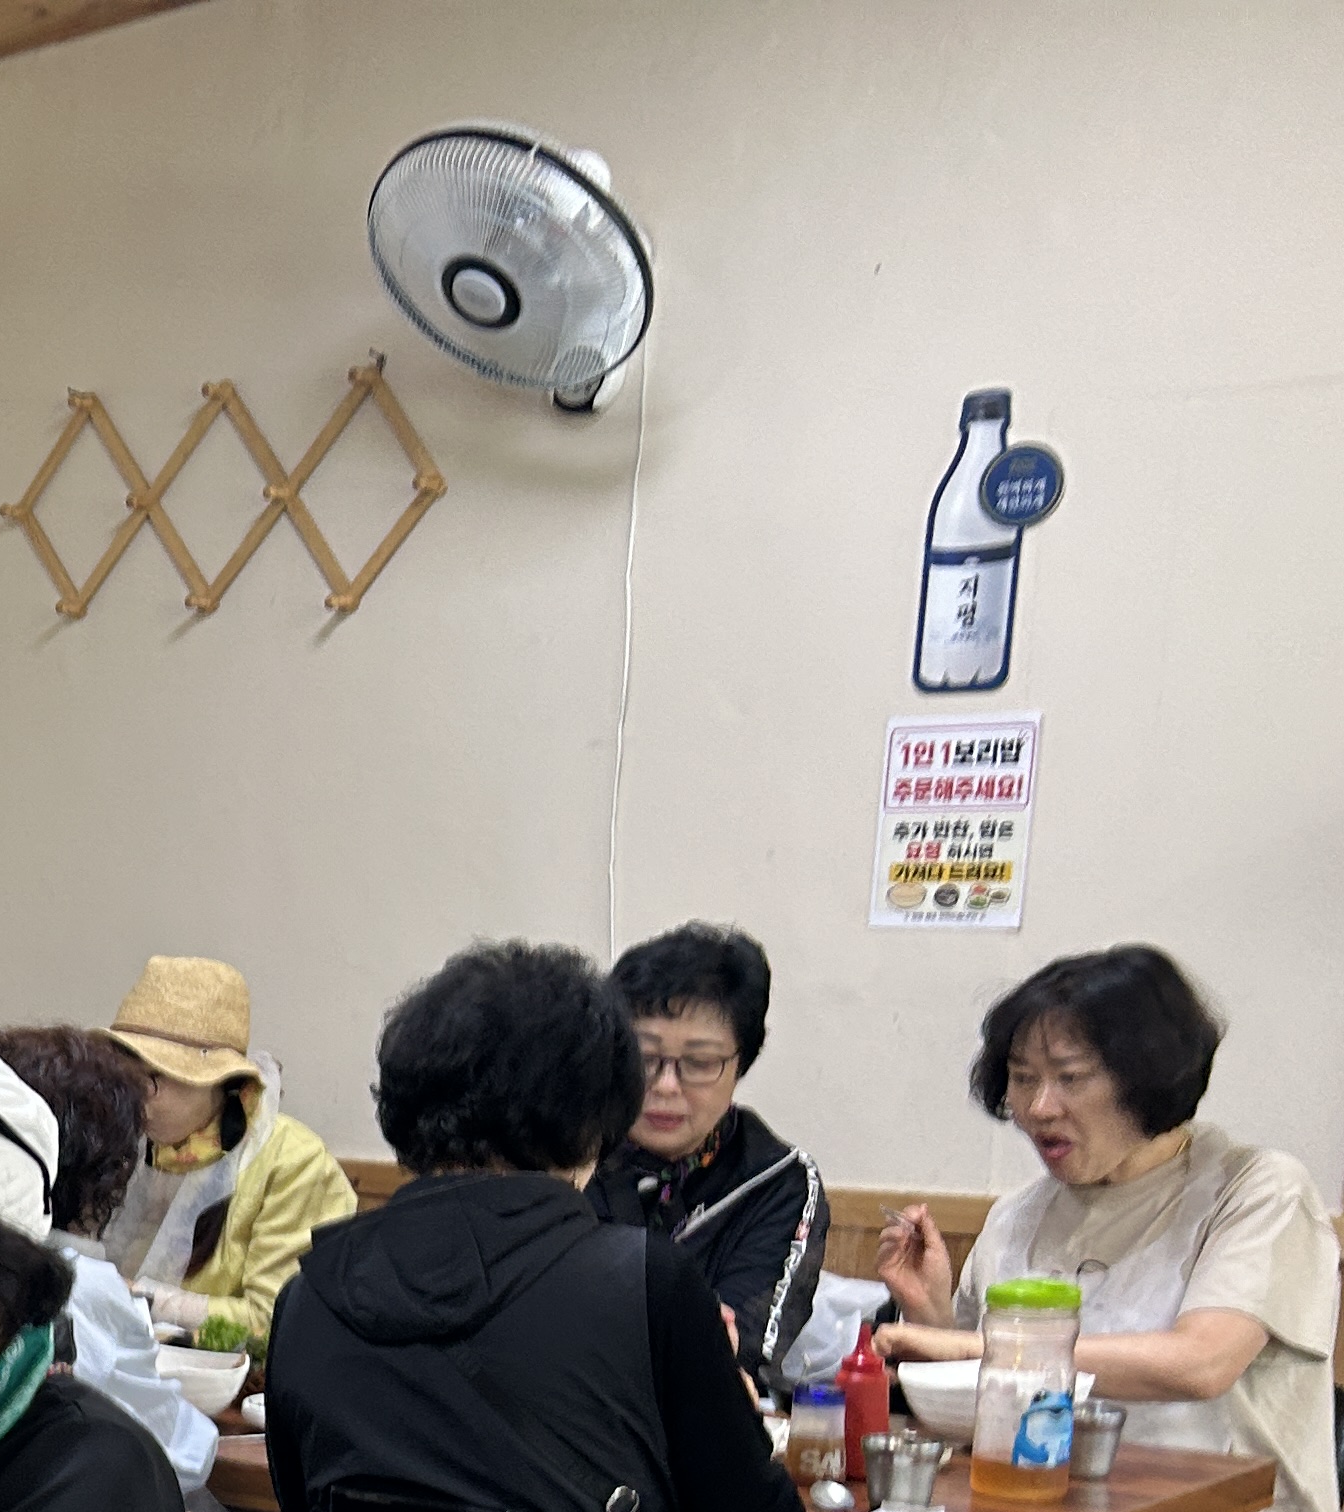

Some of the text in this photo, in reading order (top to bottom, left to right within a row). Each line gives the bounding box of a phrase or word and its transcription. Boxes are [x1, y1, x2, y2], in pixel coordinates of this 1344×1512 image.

[901, 737, 1024, 769] 1인 1보리밥
[892, 774, 1024, 805] 주문해주세요!
[893, 820, 928, 841] 추가
